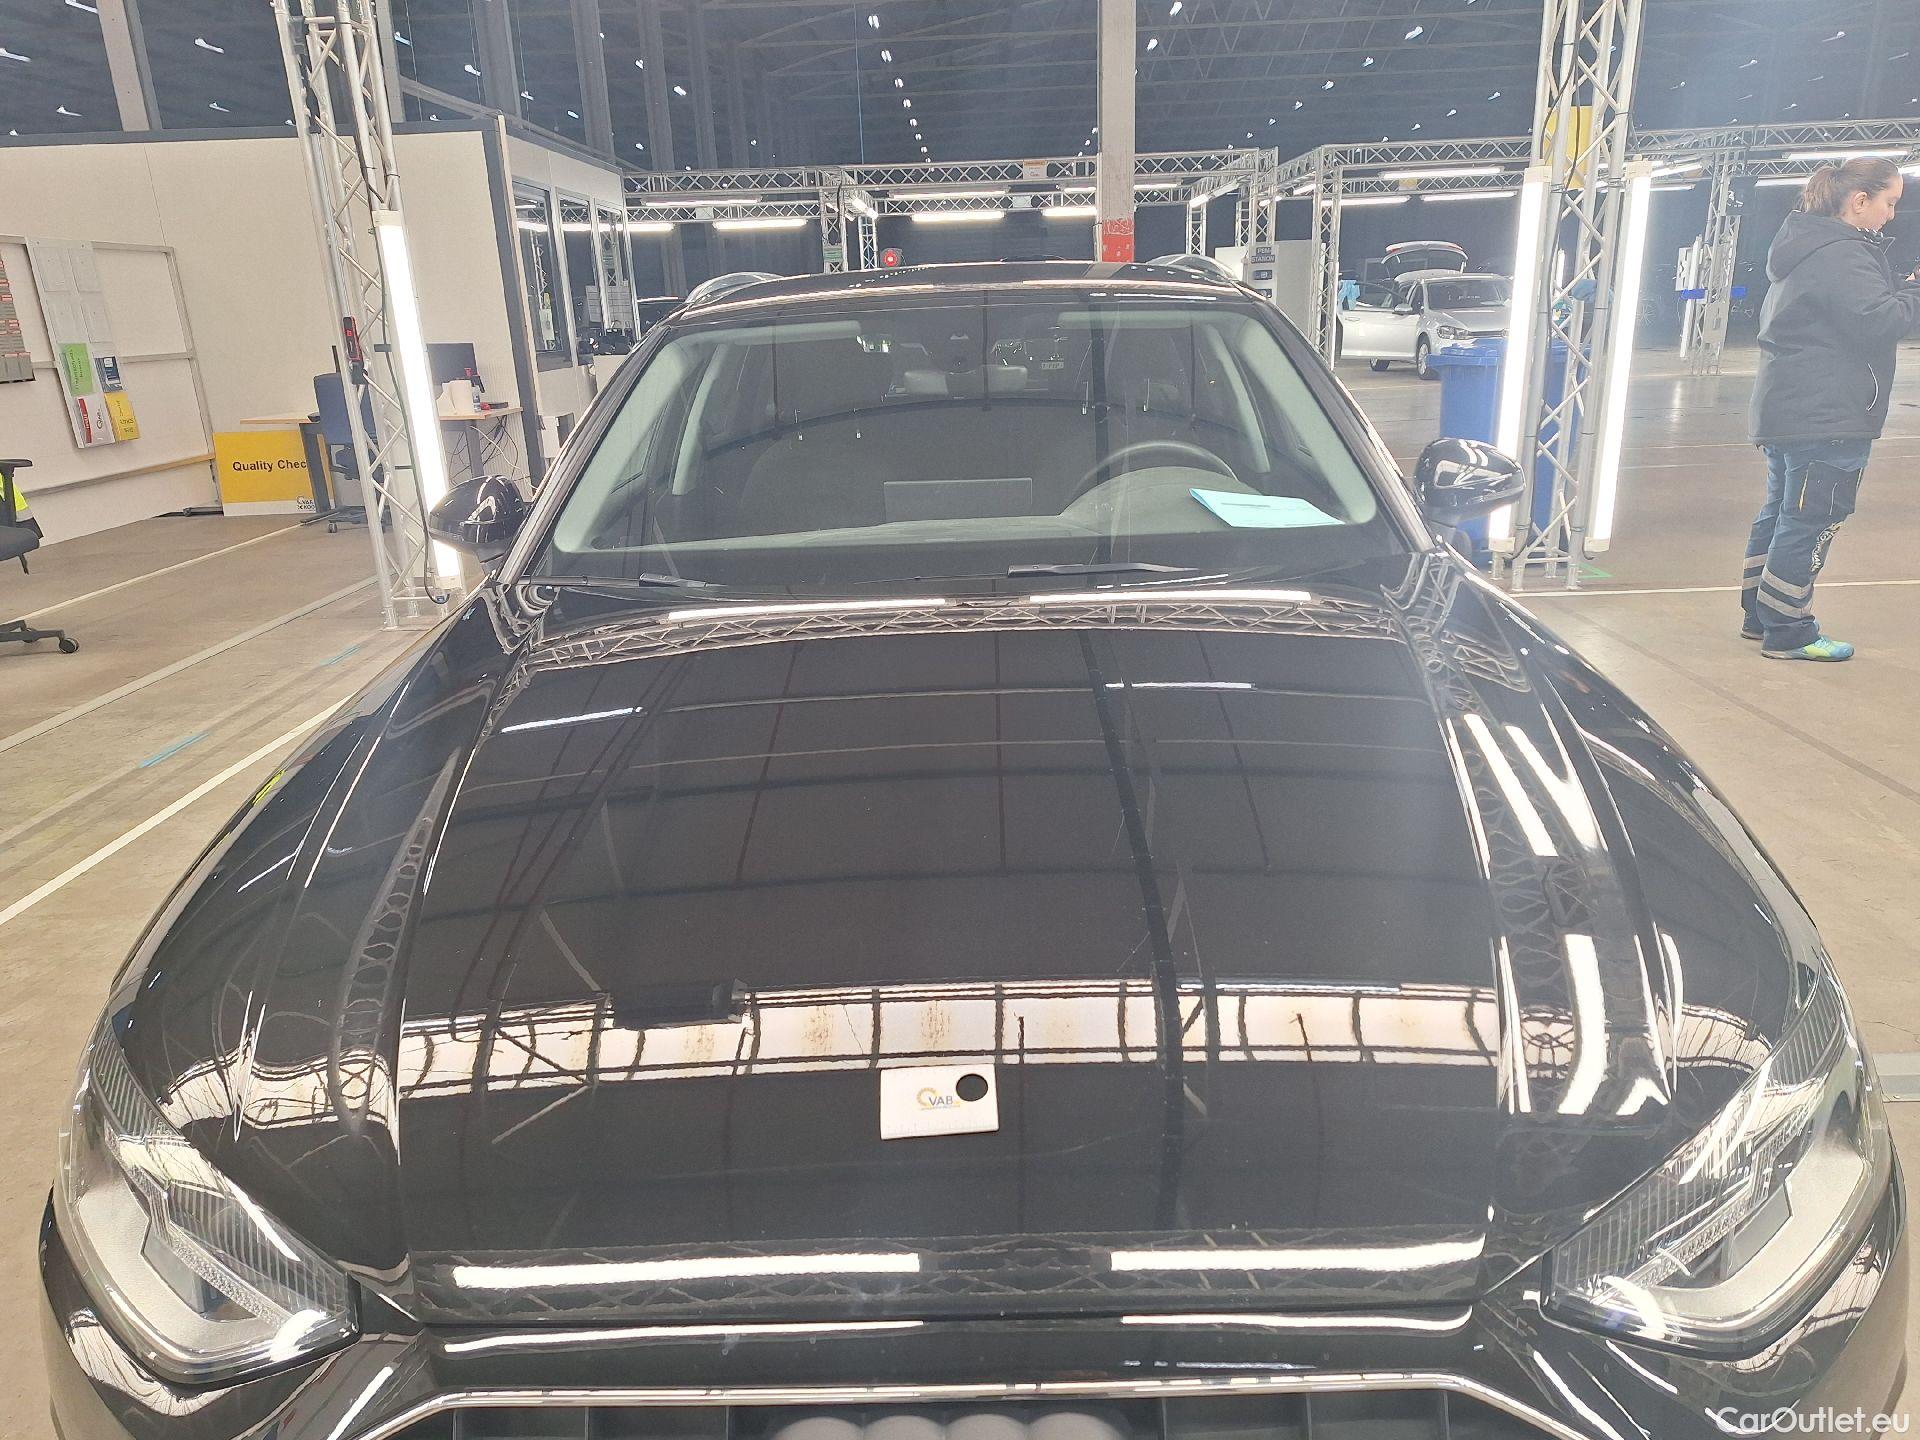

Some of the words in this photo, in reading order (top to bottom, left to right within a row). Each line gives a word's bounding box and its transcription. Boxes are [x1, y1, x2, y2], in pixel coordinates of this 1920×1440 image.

[232, 460, 273, 472] Quality
[277, 459, 307, 470] Chec
[928, 1095, 954, 1106] VAB
